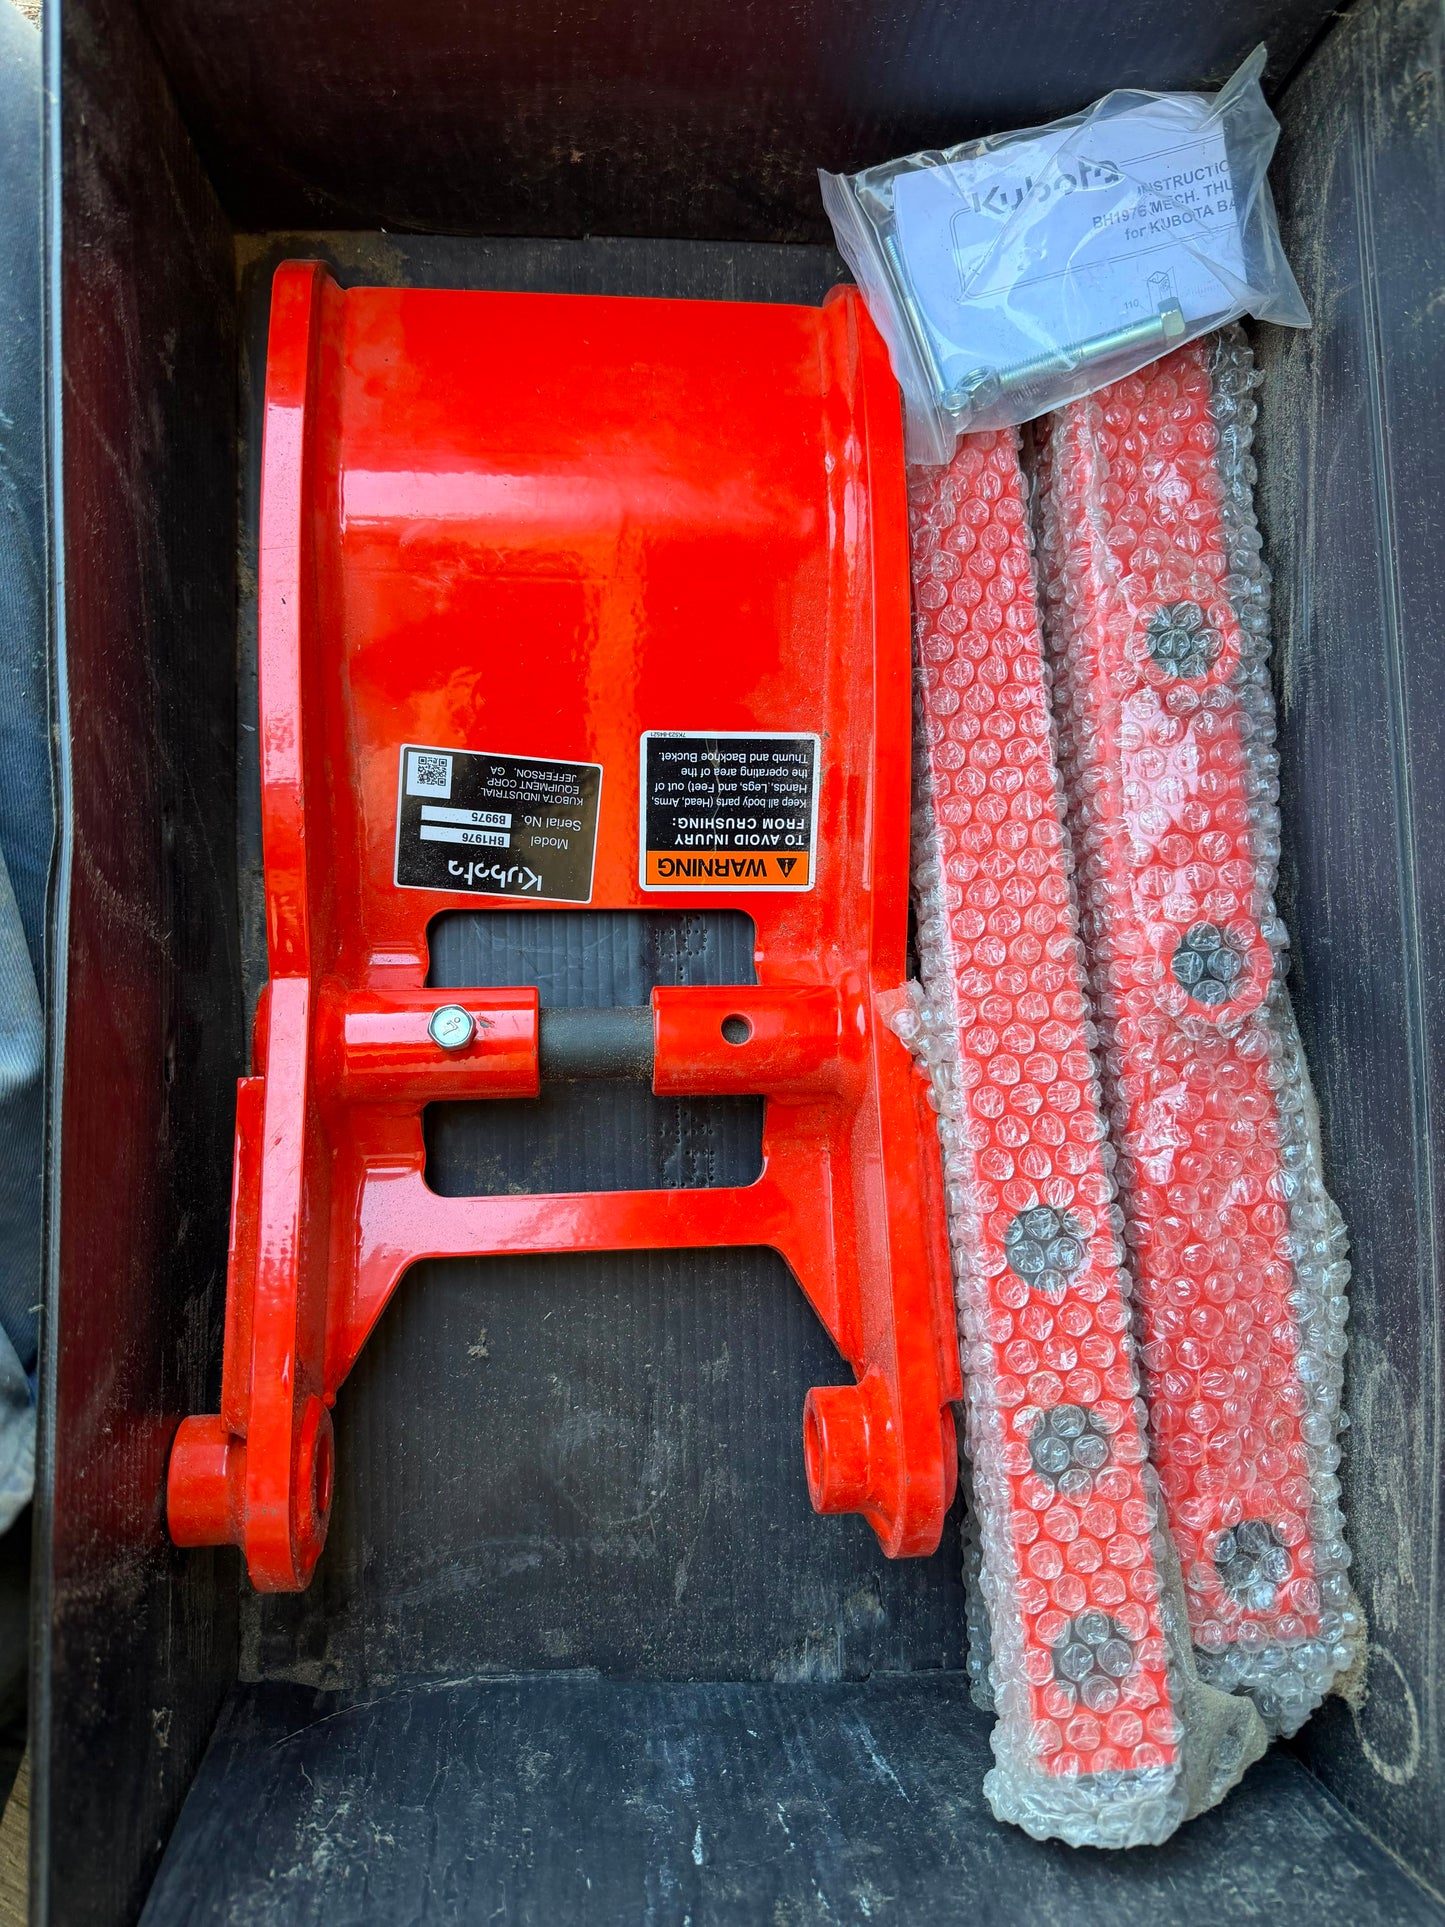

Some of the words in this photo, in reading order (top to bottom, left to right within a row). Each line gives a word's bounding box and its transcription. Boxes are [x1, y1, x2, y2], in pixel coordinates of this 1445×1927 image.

[972, 158, 1120, 214] Kubota
[1093, 204, 1147, 228] BH1976
[1148, 191, 1201, 214] MECH.
[1124, 225, 1148, 242] for
[1148, 205, 1214, 235] KUBOTA
[1124, 299, 1139, 309] 110
[659, 752, 697, 762] Bucket.
[701, 753, 746, 762] Backhoe
[750, 753, 769, 763] and
[772, 754, 807, 763] Thumb
[490, 766, 505, 775] GA
[681, 768, 697, 777] the
[700, 768, 710, 777] of
[740, 767, 788, 778] operating
[792, 769, 807, 778] the
[486, 777, 517, 787] CORP.
[519, 780, 579, 794] EQUIPMENT
[655, 783, 665, 791] of
[668, 783, 684, 791] out
[687, 781, 714, 791] Feet)
[718, 783, 737, 792] and
[740, 781, 767, 792] Legs,
[771, 782, 807, 793] Hands,
[480, 787, 540, 801] INDUSTRIAL
[543, 794, 583, 806] KUBOTA
[652, 796, 679, 806] Arms,
[682, 796, 713, 808] (Head,
[716, 795, 740, 807] parts
[742, 796, 766, 808] body
[768, 799, 779, 808] all
[782, 795, 806, 808] Keep
[471, 812, 506, 825] B9975
[521, 815, 542, 827] No.
[546, 818, 582, 830] Serial
[672, 817, 757, 829] CRUSHING:
[763, 818, 805, 829] FROM
[462, 832, 505, 846] BH1976
[531, 836, 568, 849] Model
[675, 834, 728, 845] INJURY
[734, 834, 779, 845] AVOID
[785, 834, 804, 845] TO
[658, 858, 767, 877] WARNING
[448, 860, 542, 891] Kubota
